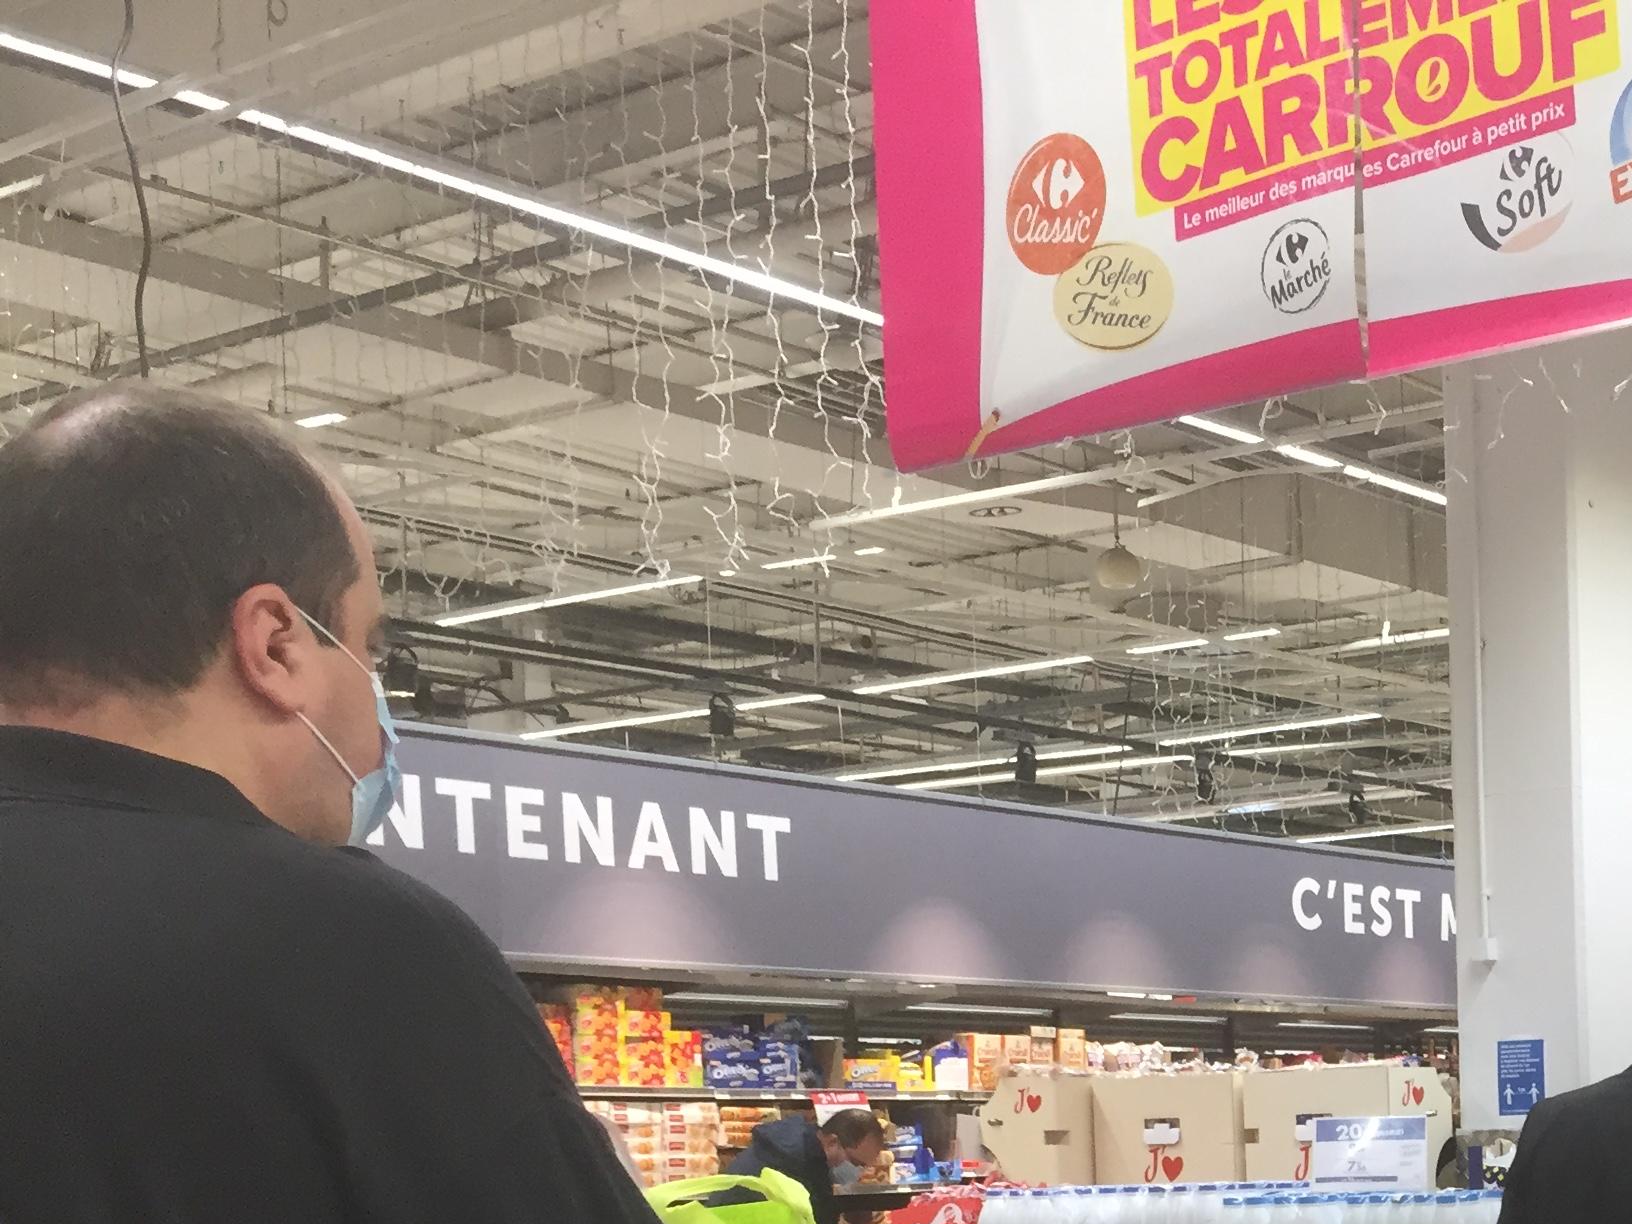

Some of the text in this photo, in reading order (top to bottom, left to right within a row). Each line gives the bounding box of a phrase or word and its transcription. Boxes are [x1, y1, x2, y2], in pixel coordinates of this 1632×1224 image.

[1134, 0, 1264, 50] LE
[1134, 0, 1500, 118] TOTALEM
[1141, 0, 1606, 202] CARROUF
[1183, 212, 1201, 230] Le
[1205, 191, 1266, 223] meilleur
[1269, 181, 1298, 201] des
[1386, 133, 1469, 172] Carrefour
[1472, 126, 1483, 145] à
[1487, 112, 1527, 145] petit
[1531, 102, 1566, 131] prix
[1496, 156, 1562, 237] Soft
[1076, 255, 1154, 298] Reflets
[1271, 251, 1332, 309] Marché
[1067, 291, 1152, 330] France
[1292, 877, 1422, 939] C'EST
